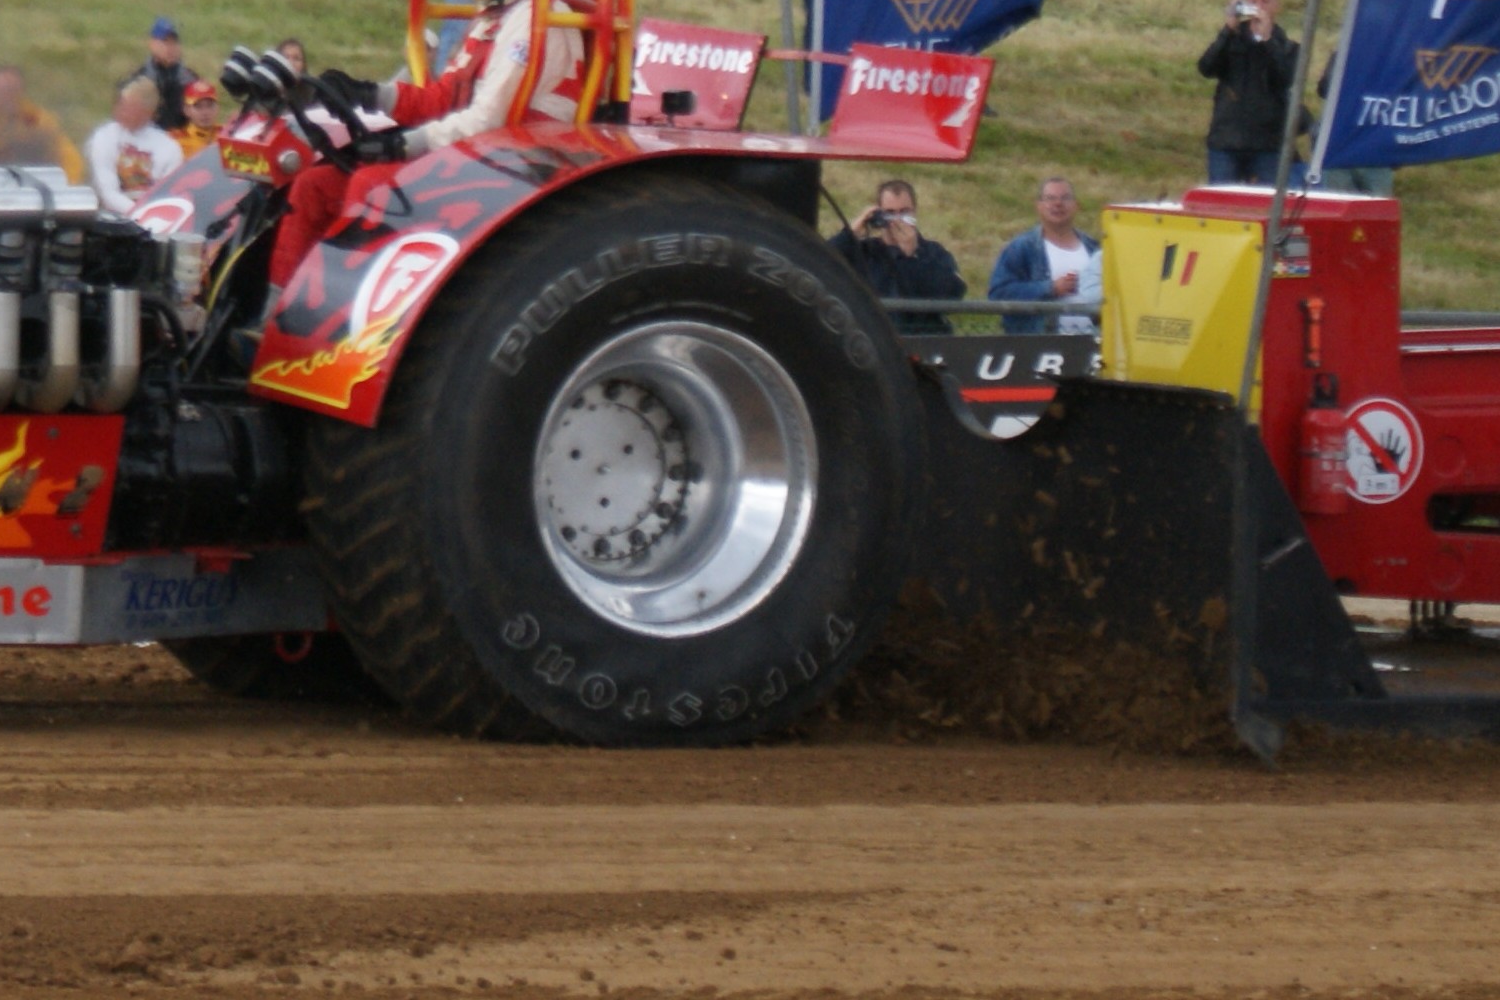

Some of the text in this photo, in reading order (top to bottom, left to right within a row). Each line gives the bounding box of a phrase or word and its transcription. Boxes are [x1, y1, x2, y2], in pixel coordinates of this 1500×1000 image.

[634, 32, 755, 75] Firestone
[849, 56, 981, 102] Firestone
[490, 231, 733, 377] PULLER
